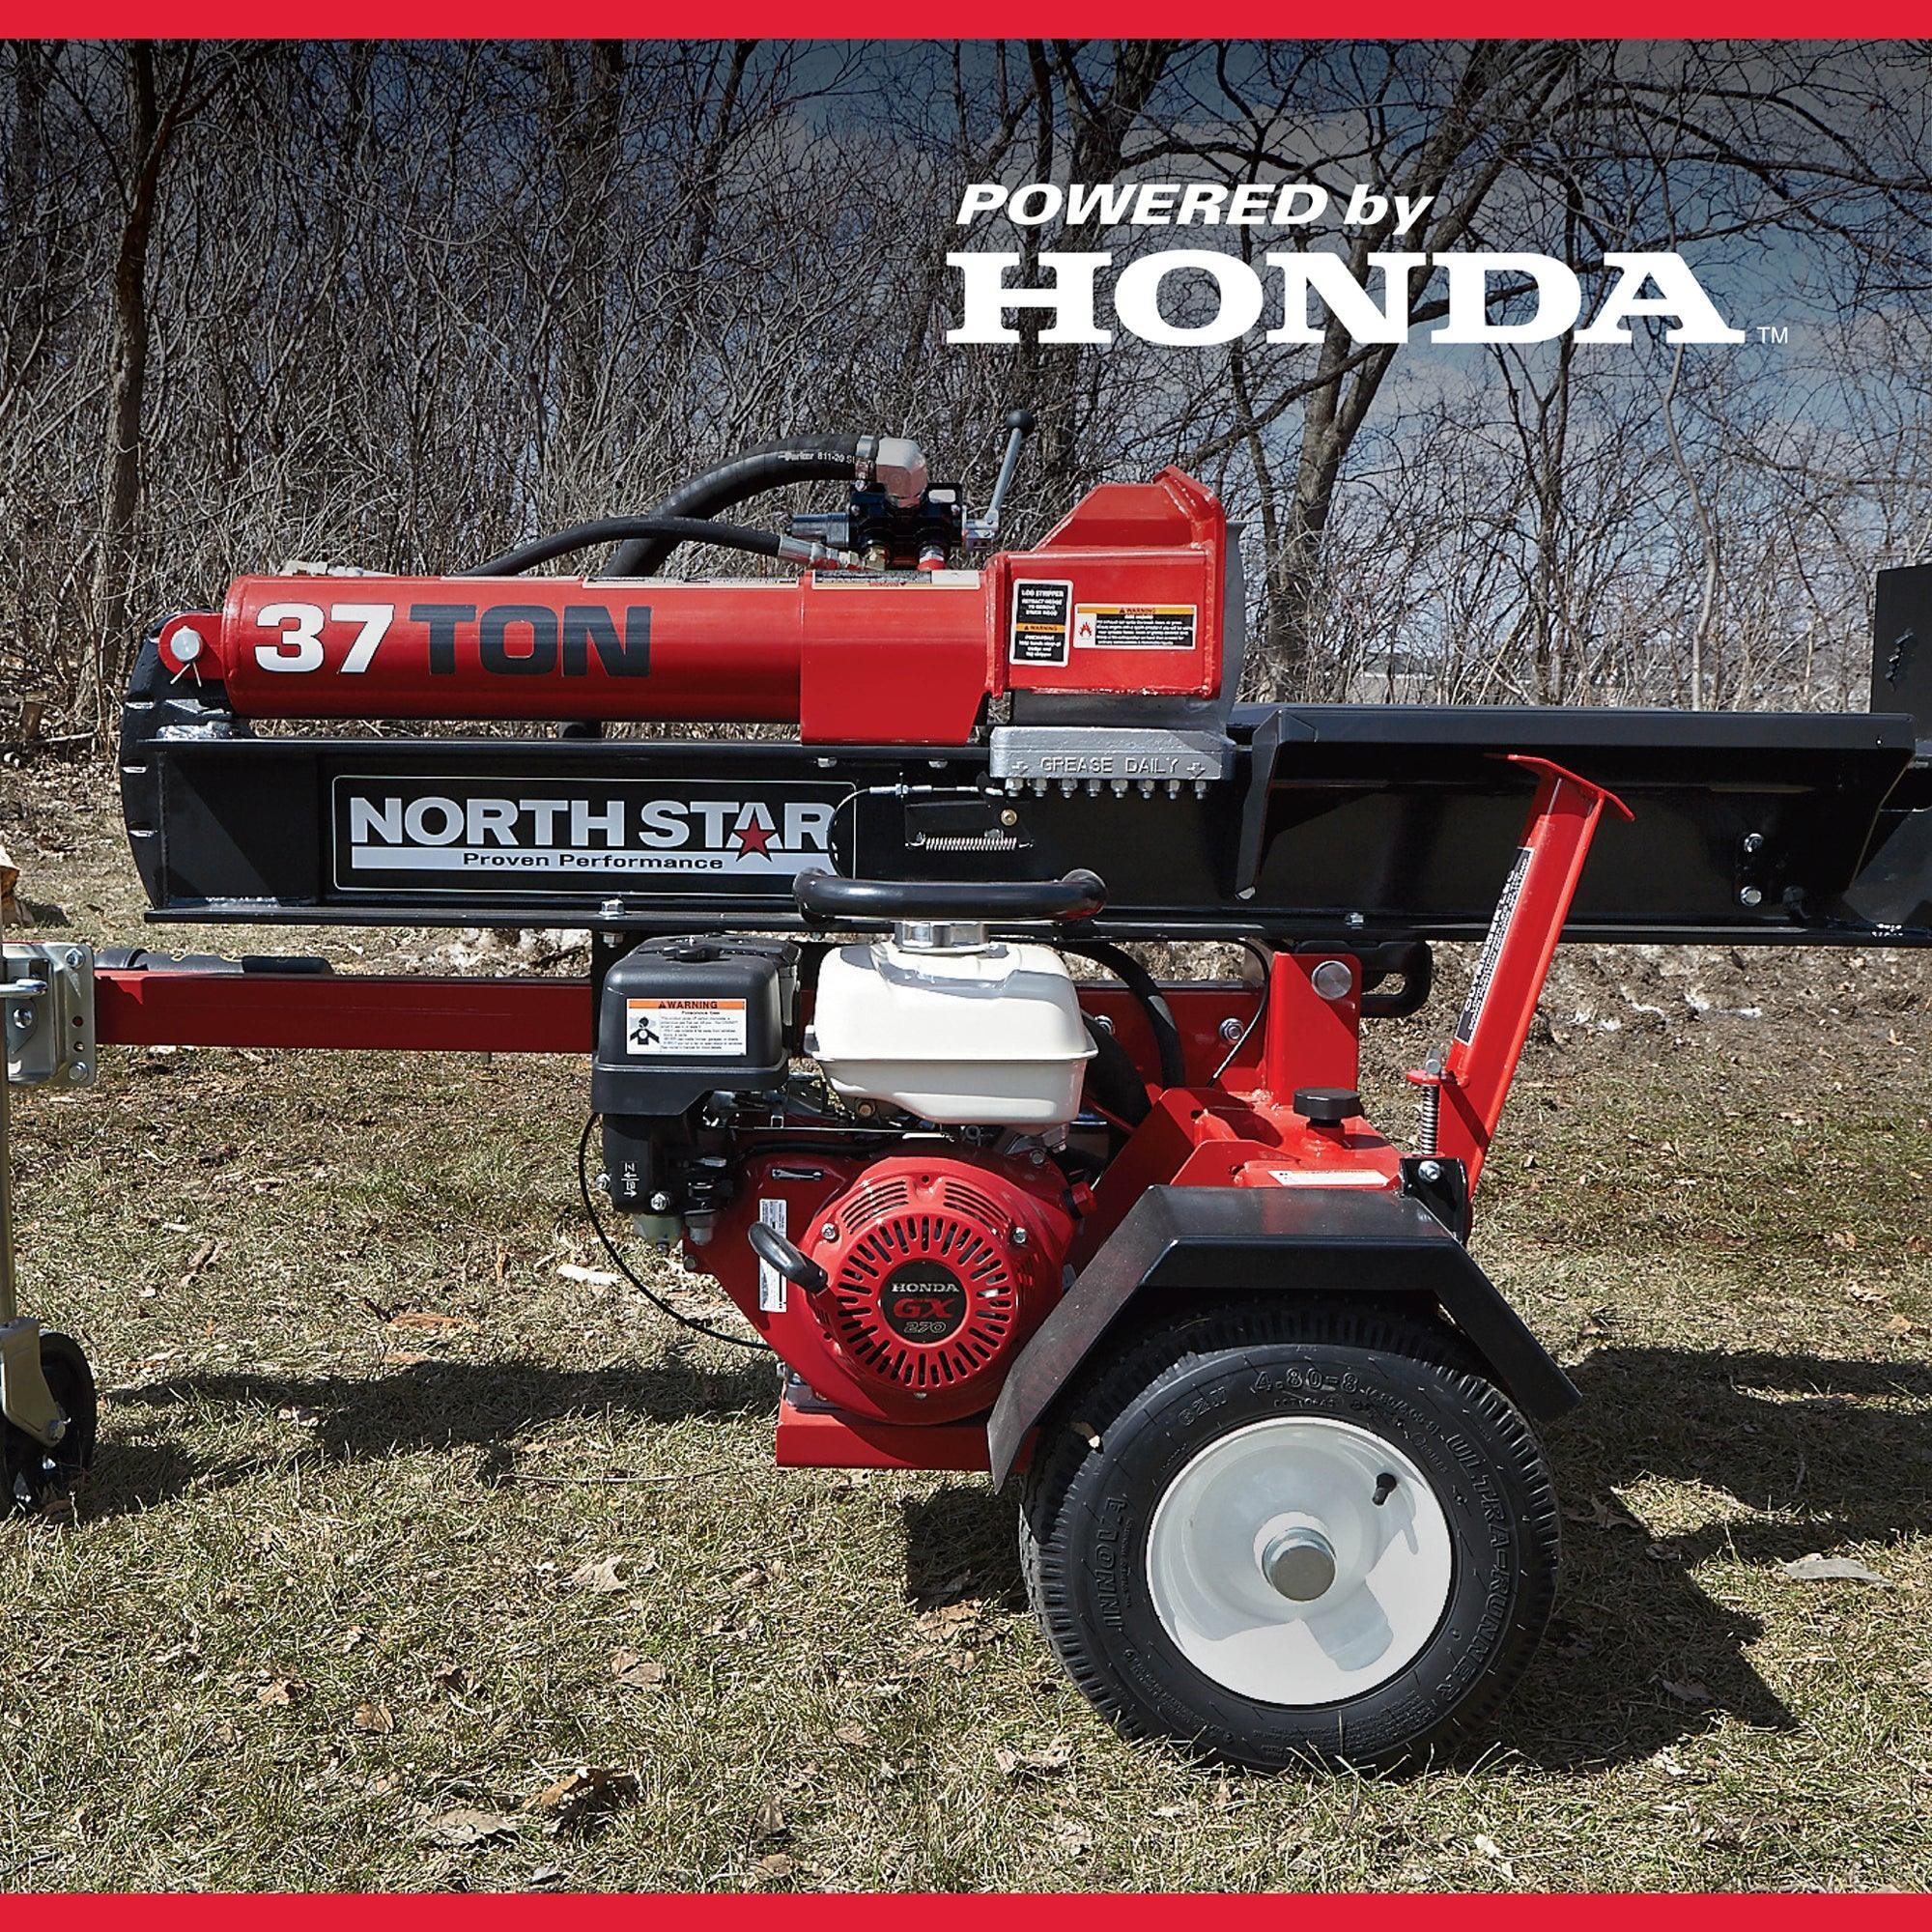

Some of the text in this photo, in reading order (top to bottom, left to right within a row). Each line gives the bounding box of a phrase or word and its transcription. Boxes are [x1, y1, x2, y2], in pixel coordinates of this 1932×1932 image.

[254, 603, 652, 676] 37 TON
[1040, 756, 1179, 774] GREASE DAILY
[351, 797, 838, 850] NORTH STAR
[463, 851, 724, 870] Proven Performance
[892, 1283, 959, 1293] HONDA
[894, 1297, 956, 1320] GX
[904, 1321, 947, 1334] 270
